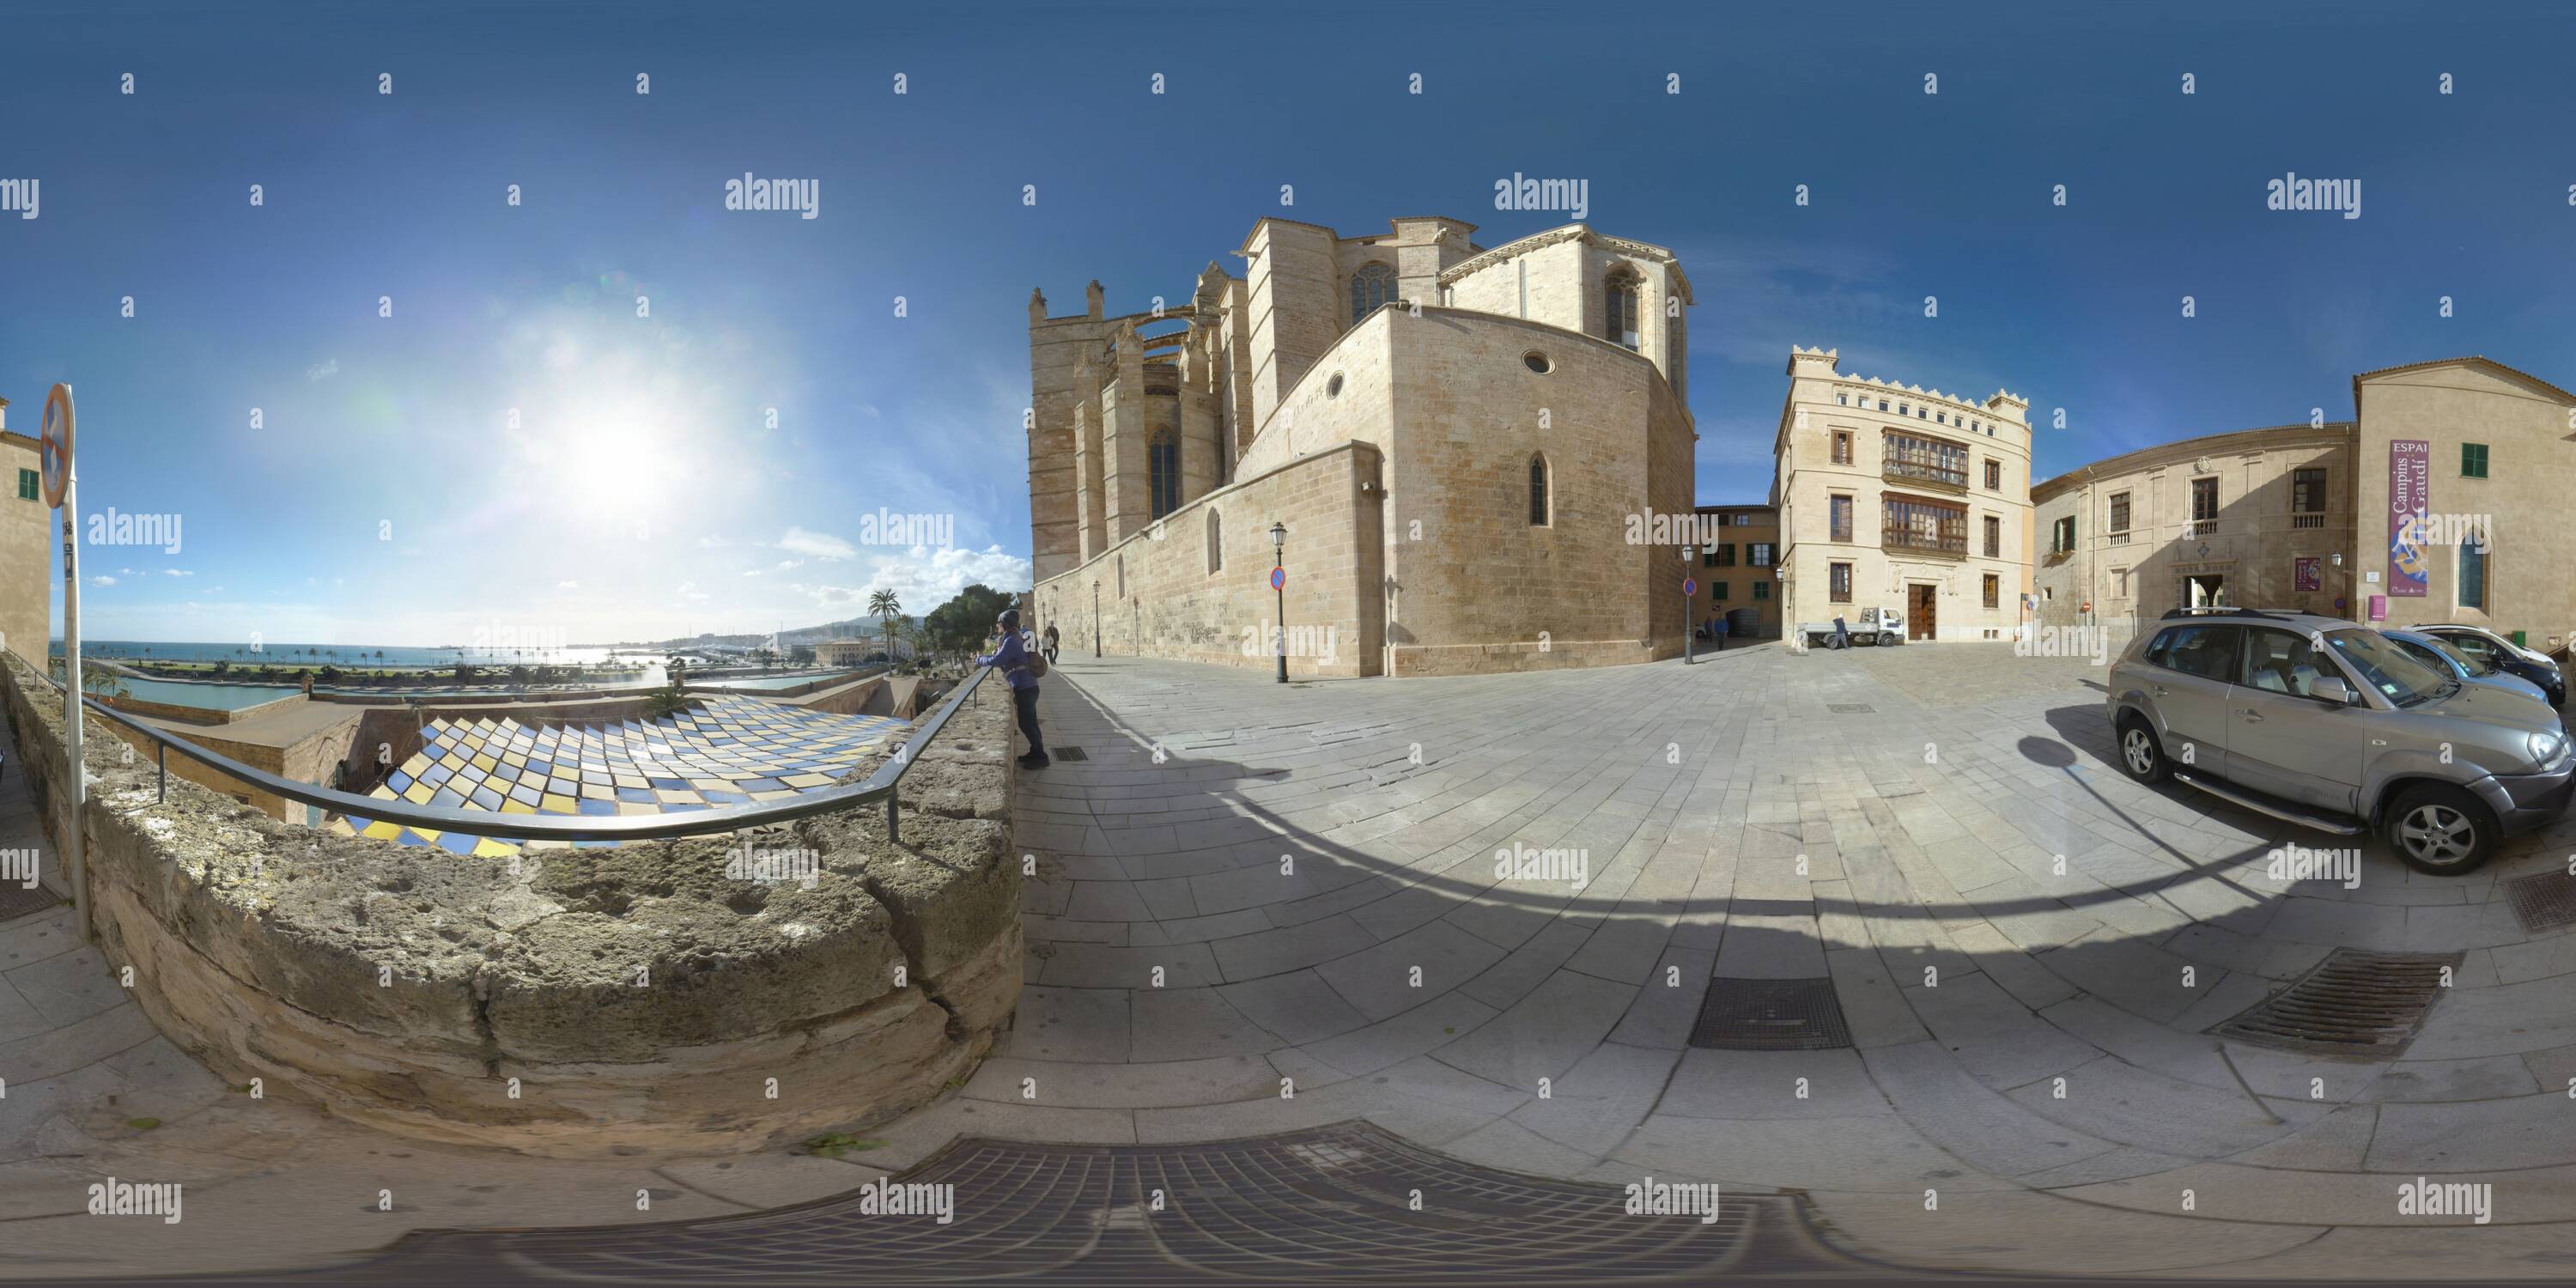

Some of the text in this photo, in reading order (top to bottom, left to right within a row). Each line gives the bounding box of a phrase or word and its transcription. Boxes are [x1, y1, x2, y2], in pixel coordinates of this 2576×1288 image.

[2393, 443, 2427, 453] ESPAI
[2393, 458, 2412, 513] Campins
[2411, 459, 2426, 513] Gaudí
